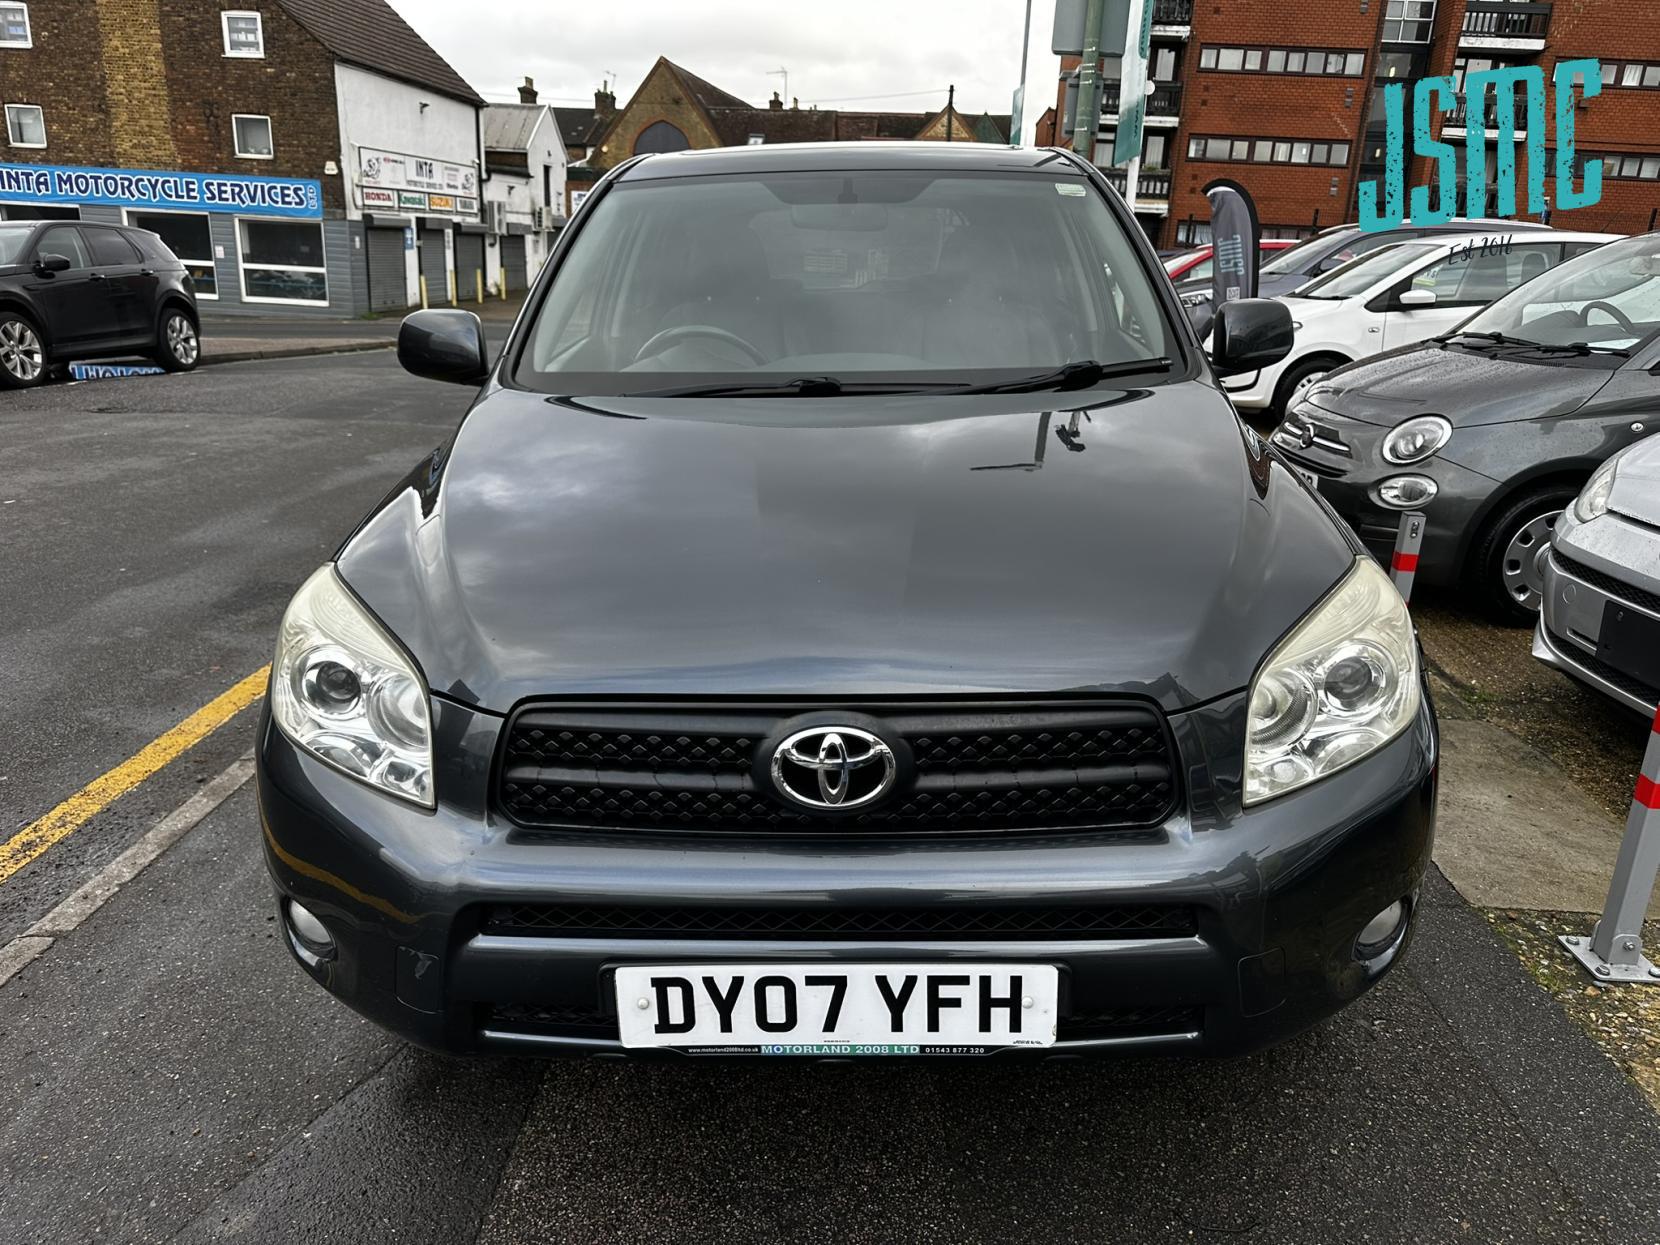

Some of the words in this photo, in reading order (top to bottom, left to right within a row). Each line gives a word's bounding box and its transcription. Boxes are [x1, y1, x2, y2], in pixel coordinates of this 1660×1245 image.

[55, 172, 199, 202] MOTORCYCLE
[203, 179, 306, 208] SERVICES
[364, 191, 392, 202] HONDA
[650, 975, 848, 1033] DY07
[874, 974, 1023, 1034] YFH
[761, 1045, 851, 1054] MOTORLAND
[855, 1045, 890, 1054] 2008
[893, 1045, 920, 1054] LTD
